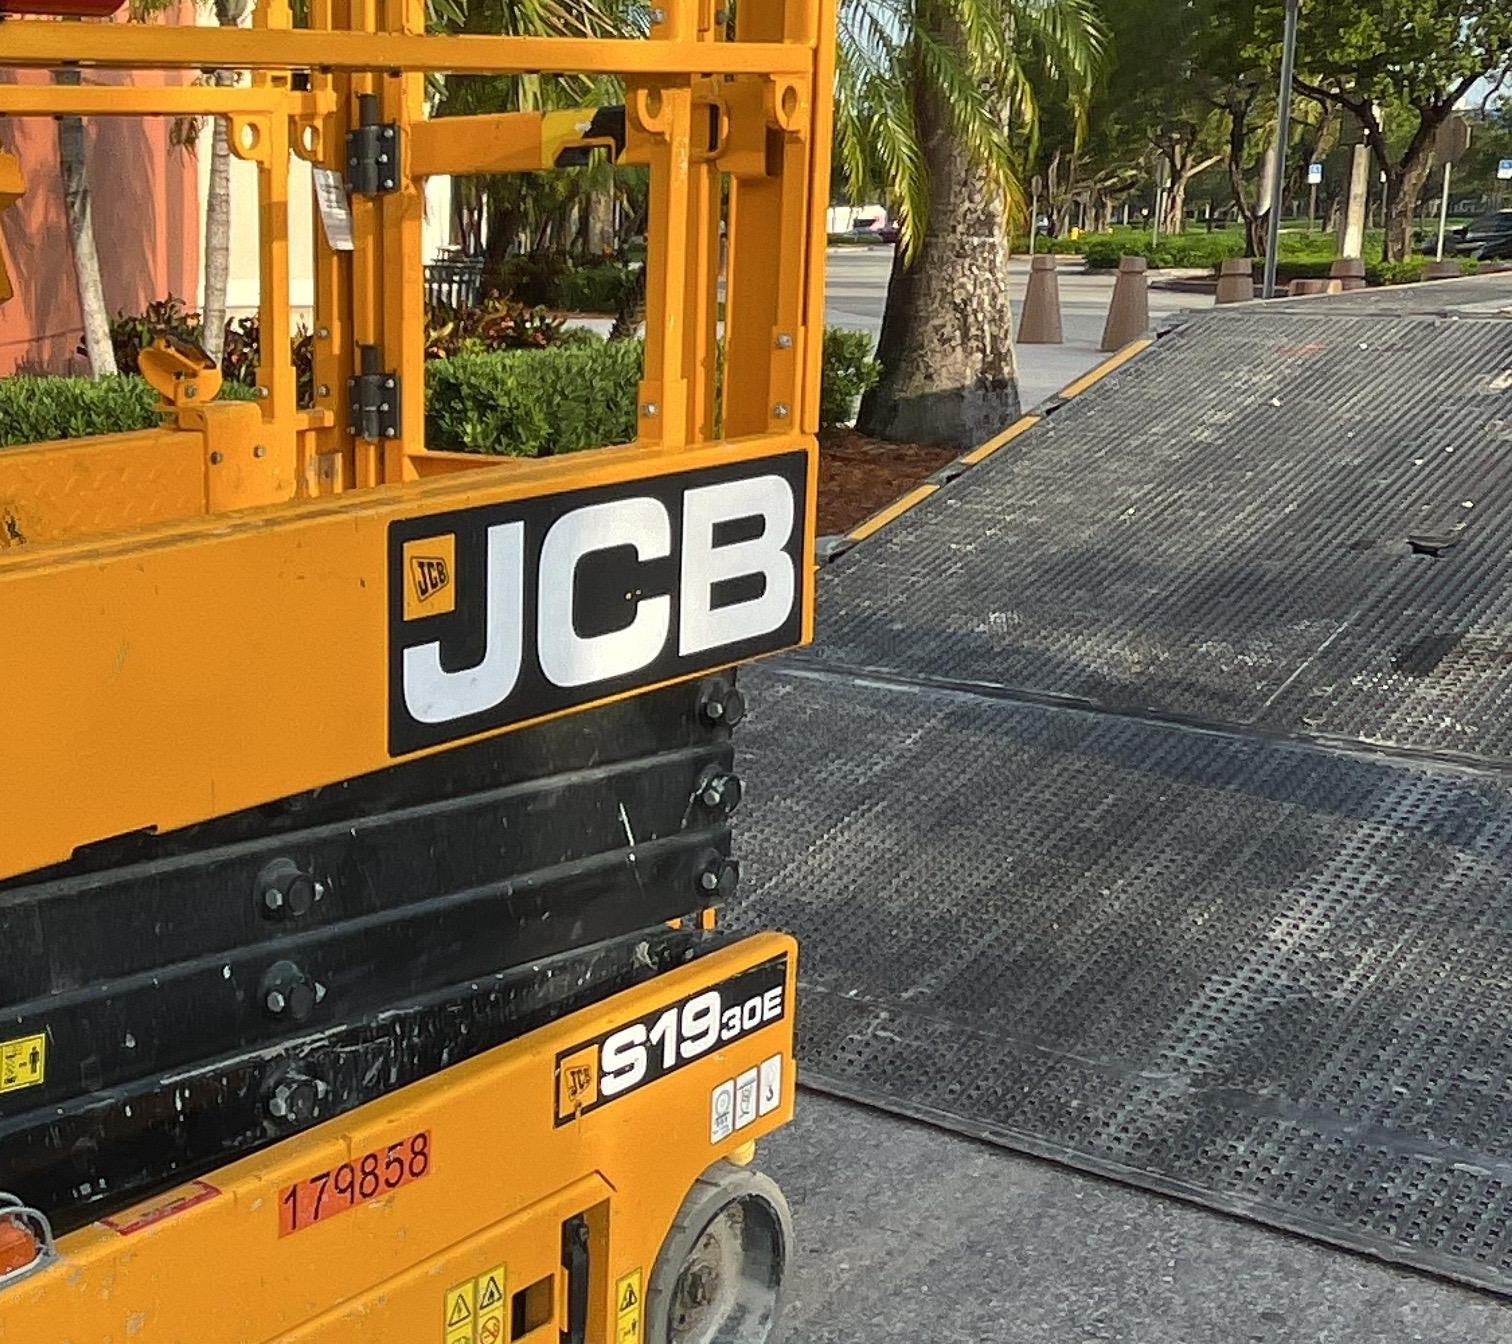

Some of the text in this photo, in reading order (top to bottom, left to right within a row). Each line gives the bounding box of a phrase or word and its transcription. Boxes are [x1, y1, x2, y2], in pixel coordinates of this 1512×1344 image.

[402, 474, 795, 724] JCB
[415, 558, 449, 602] JCB
[282, 1132, 429, 1231] 179858
